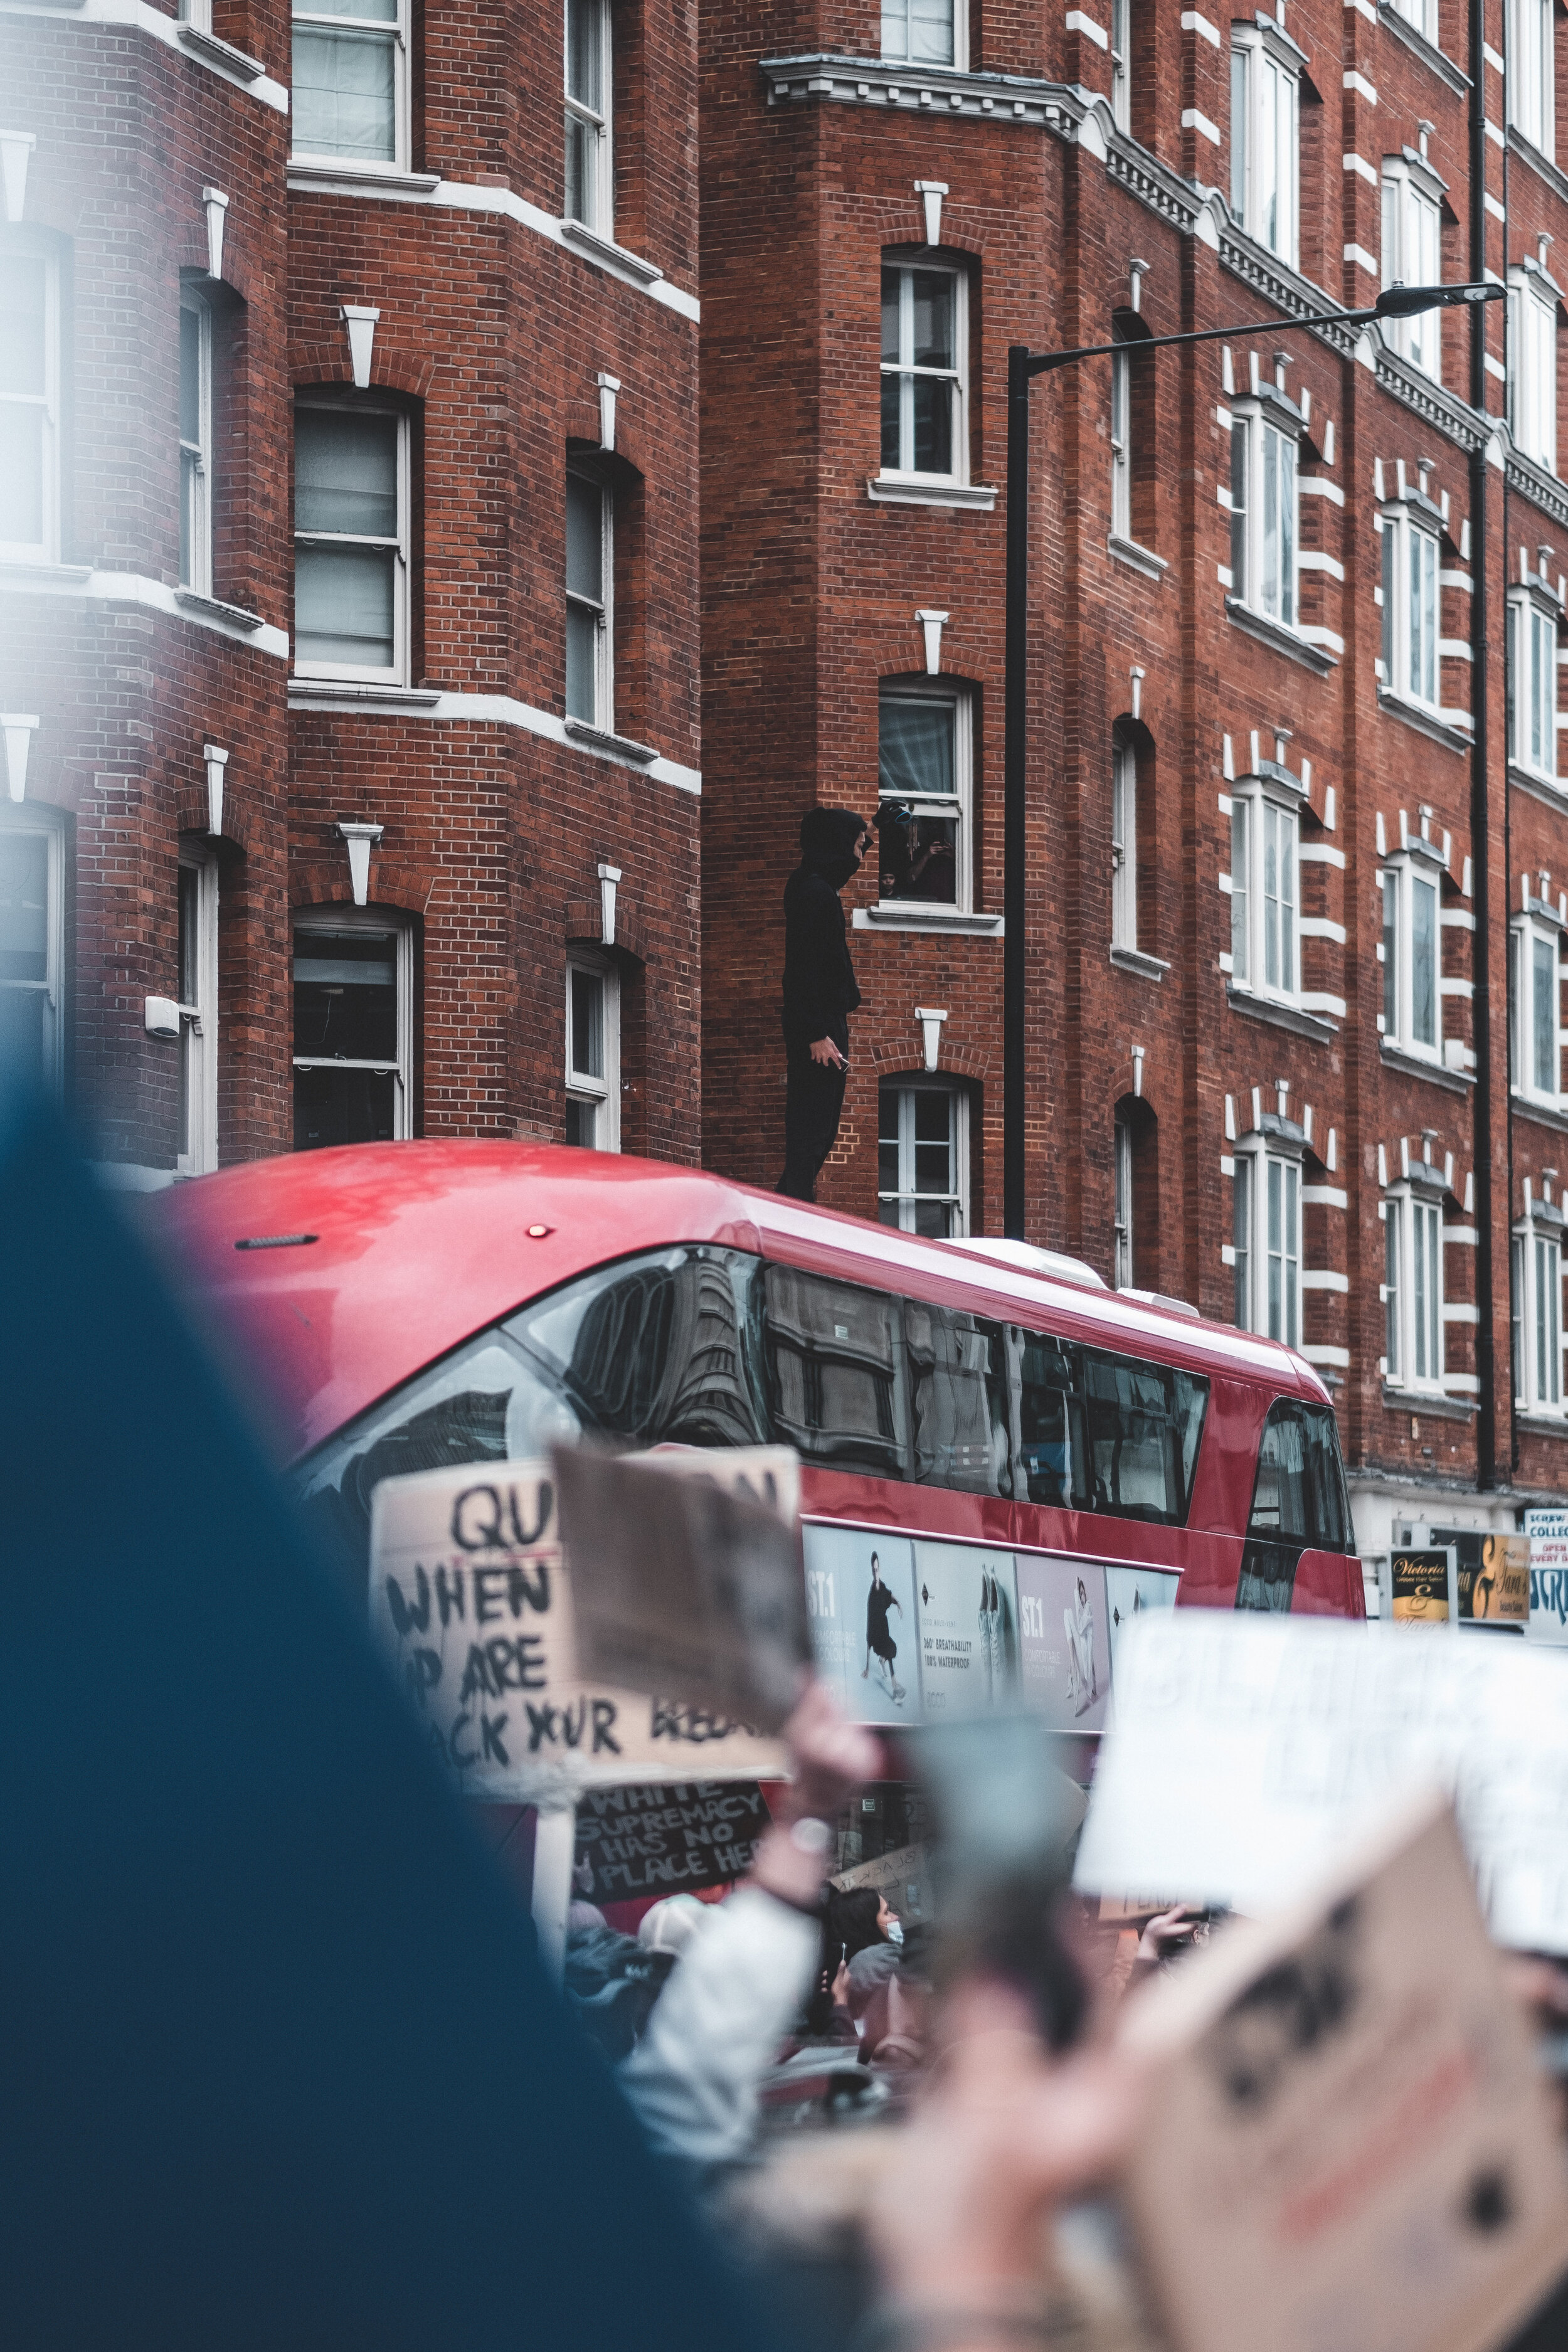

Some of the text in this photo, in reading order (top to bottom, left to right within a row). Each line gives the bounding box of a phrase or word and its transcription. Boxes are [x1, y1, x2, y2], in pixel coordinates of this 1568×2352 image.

[1530, 1554, 1558, 1562] EVERY
[1543, 1544, 1567, 1552] OPEN
[1394, 1556, 1446, 1576] Victoria
[386, 1559, 552, 1636] WHEN
[808, 1570, 835, 1617] ST.1
[1022, 1595, 1043, 1638] ST.1
[924, 1654, 970, 1669] 100% WATERPROOF
[936, 1638, 972, 1653] BREATHABILITY
[1024, 1648, 1061, 1664] COMFORTABLE
[458, 1634, 547, 1704] ARE
[588, 1783, 723, 1814] WHITE
[575, 1793, 760, 1842] SUPREMACY
[600, 1822, 734, 1863] HAS NO
[598, 1851, 709, 1890] PLACE
